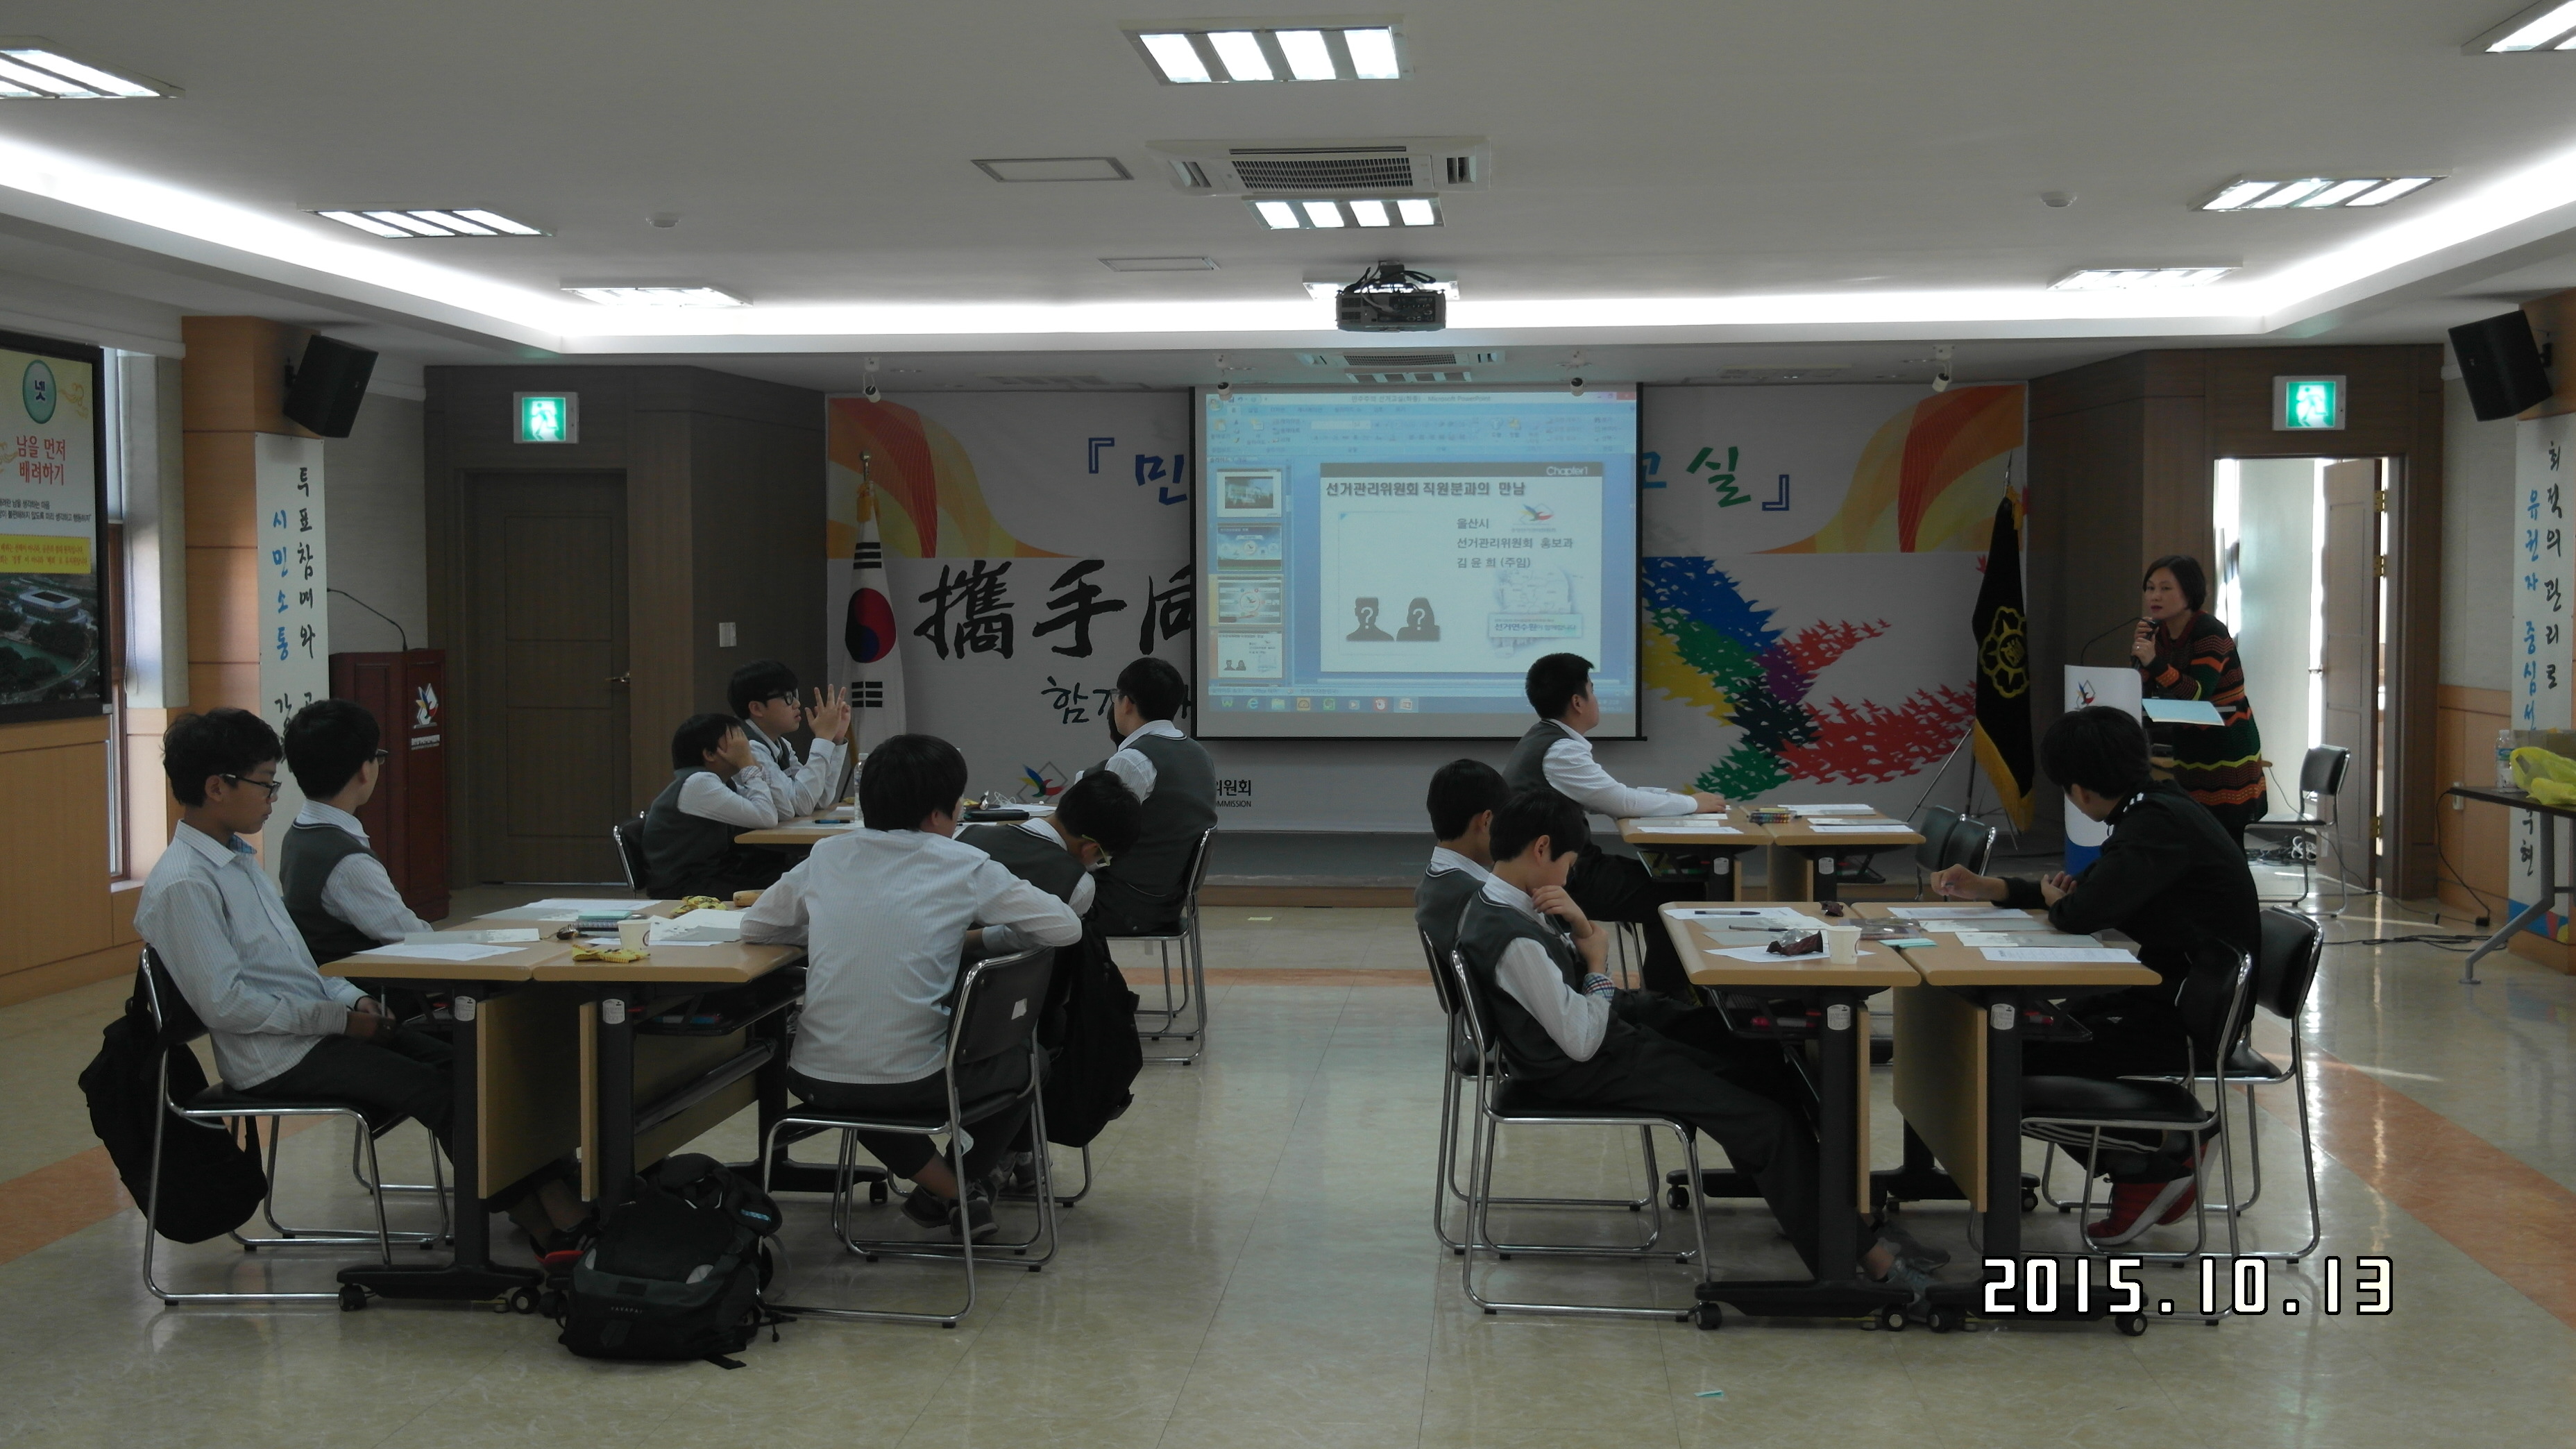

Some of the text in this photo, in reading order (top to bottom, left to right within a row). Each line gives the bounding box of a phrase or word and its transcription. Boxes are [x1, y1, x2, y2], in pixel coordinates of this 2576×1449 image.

[34, 380, 46, 401] 넷
[17, 434, 66, 461] 남을 먼저
[19, 460, 65, 486] 배려하기
[1546, 466, 1588, 477] Chapter1
[1326, 482, 1526, 496] 선거관리위원회 직원분과의 만남
[1457, 518, 1489, 529] 울산시
[1457, 538, 1573, 549] 선거관리위원회 홍보과
[1457, 557, 1467, 568] 김
[1471, 557, 1481, 568] 윤
[1500, 557, 1531, 569] (주임)
